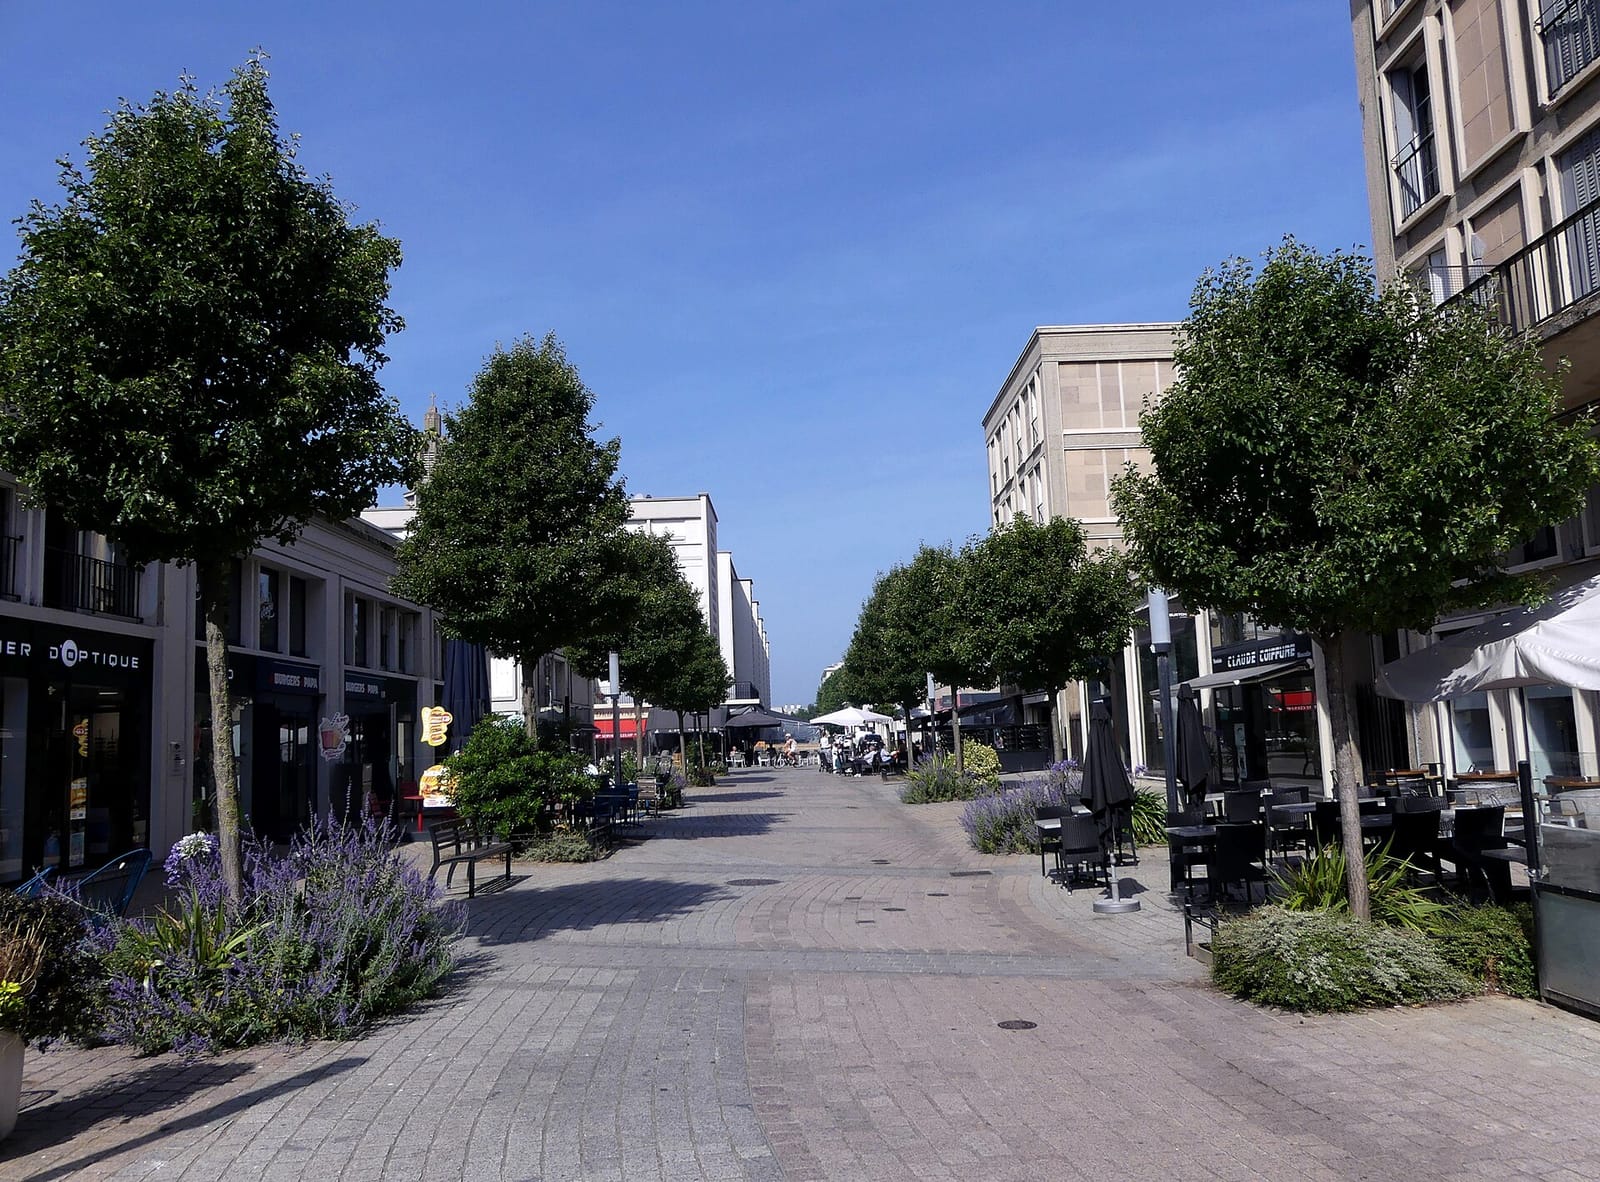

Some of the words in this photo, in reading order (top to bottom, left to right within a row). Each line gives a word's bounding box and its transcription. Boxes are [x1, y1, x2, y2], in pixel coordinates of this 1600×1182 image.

[1227, 651, 1256, 668] CLAUDE
[1259, 643, 1296, 662] COIFFURE
[274, 673, 301, 687] BURGERS
[303, 677, 318, 689] PAPA
[345, 681, 365, 694] BURGERS
